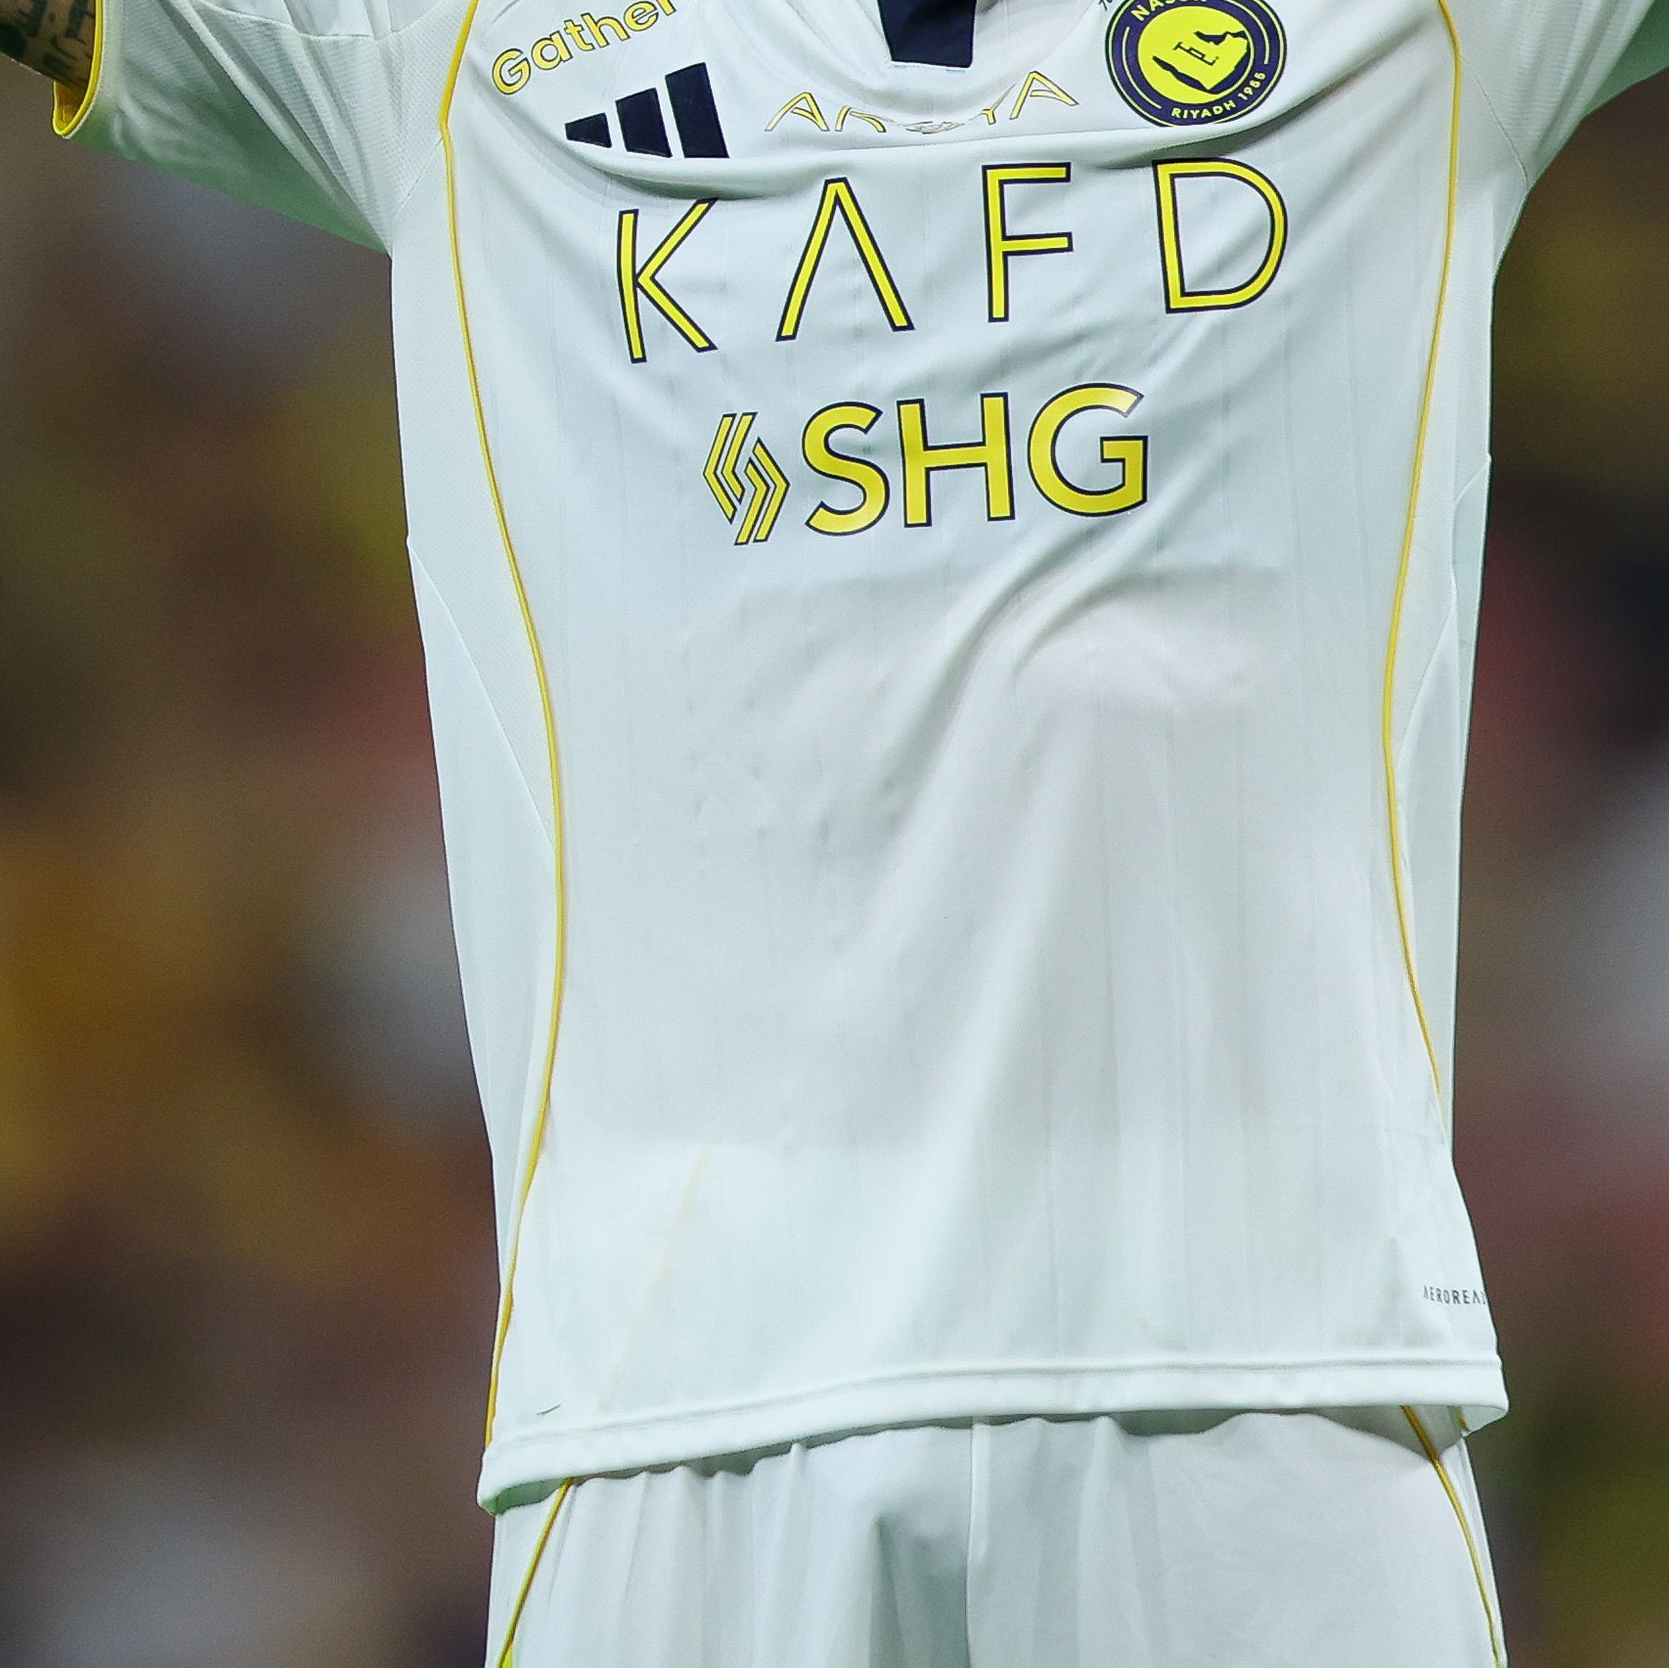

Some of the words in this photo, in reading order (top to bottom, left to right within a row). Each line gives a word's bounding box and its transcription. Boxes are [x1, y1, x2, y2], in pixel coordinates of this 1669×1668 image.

[1170, 99, 1236, 119] RIYADH
[615, 157, 1289, 365] KAFD
[801, 382, 1150, 536] SHG
